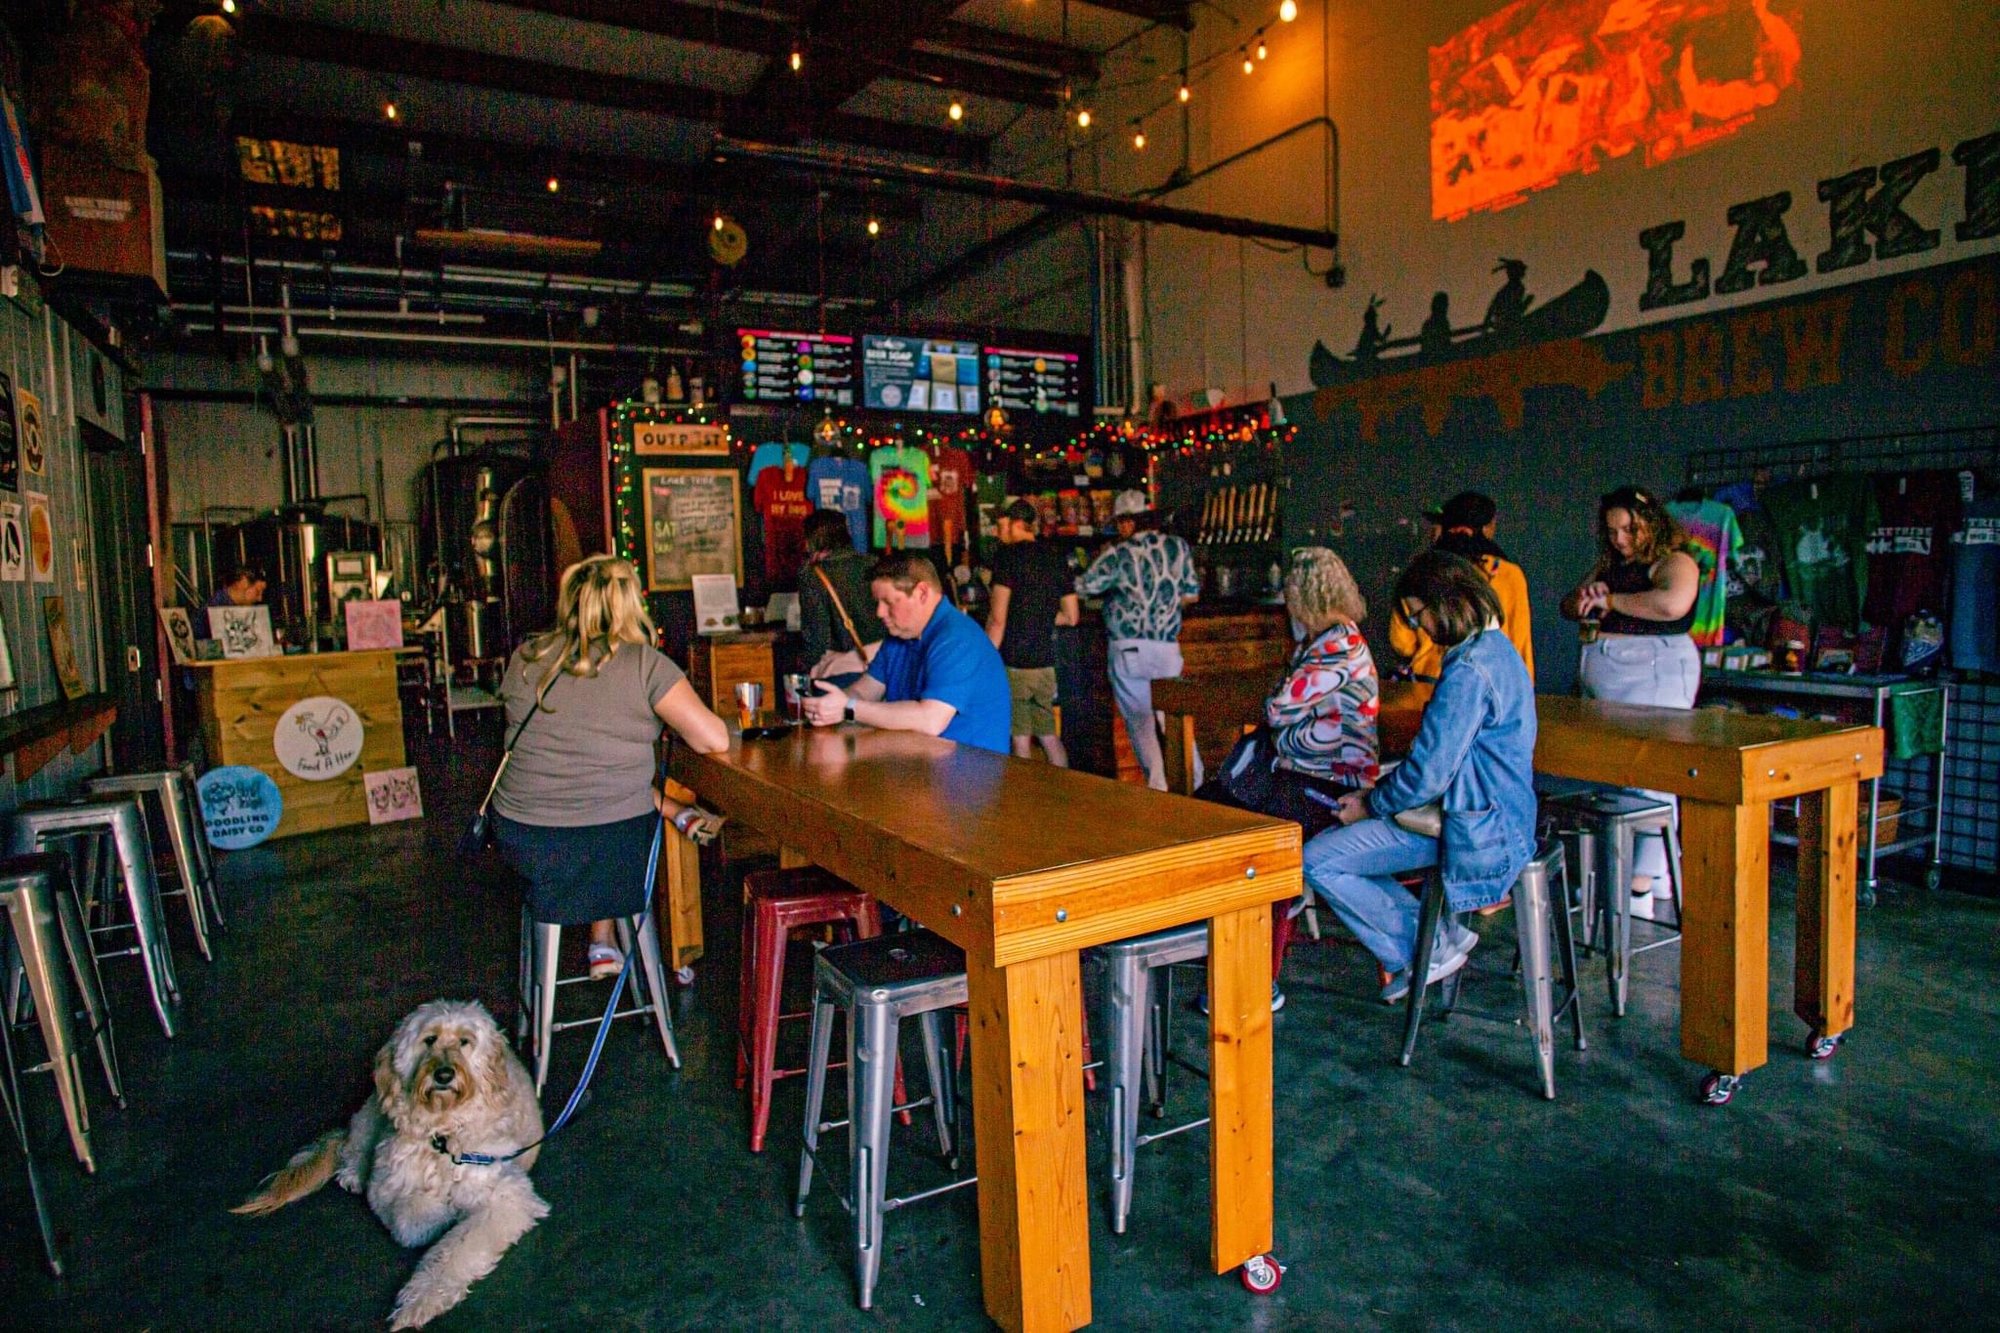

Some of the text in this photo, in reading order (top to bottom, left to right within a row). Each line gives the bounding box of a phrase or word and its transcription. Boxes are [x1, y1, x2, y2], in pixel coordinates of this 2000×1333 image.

[1639, 267, 1998, 410] BREW CO
[325, 756, 333, 770] A
[213, 825, 264, 838] DAISY CO
